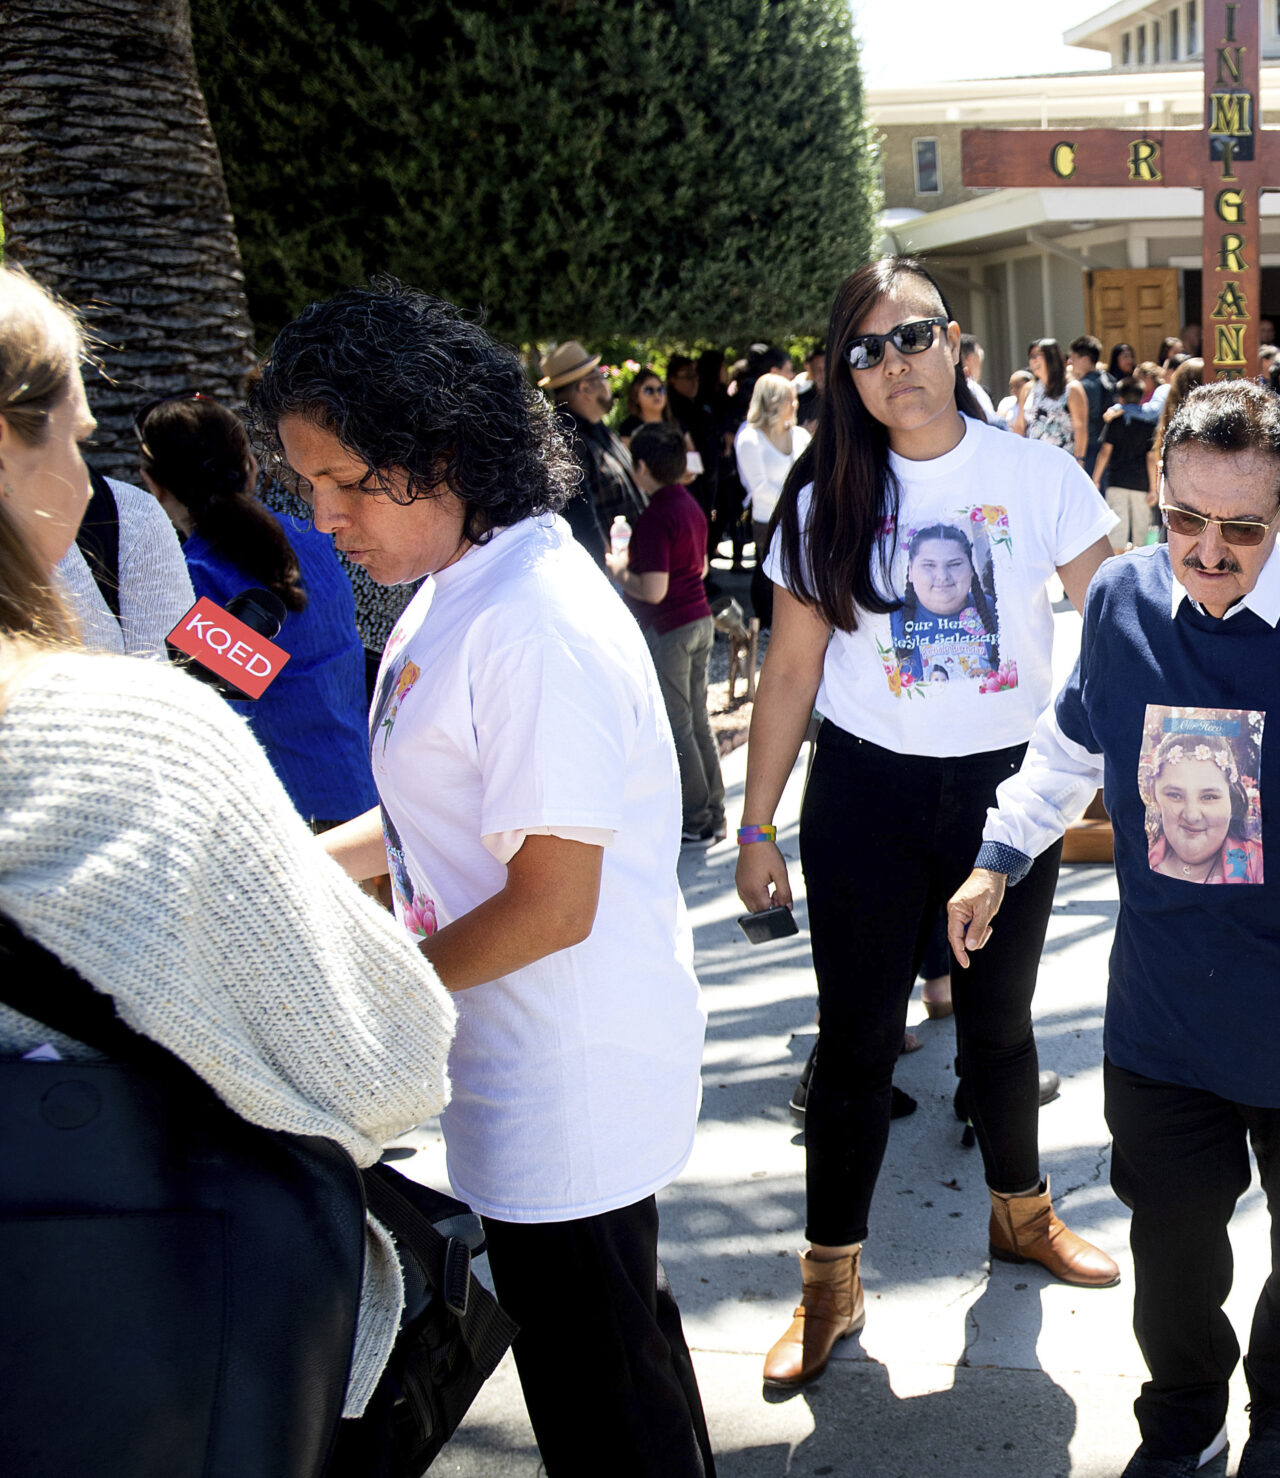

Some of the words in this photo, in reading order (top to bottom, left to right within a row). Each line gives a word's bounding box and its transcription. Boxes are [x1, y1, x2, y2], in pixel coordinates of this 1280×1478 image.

[905, 620, 933, 633] Our
[937, 618, 977, 630] Hero
[185, 613, 272, 677] KQED
[934, 632, 1001, 646] Salazar
